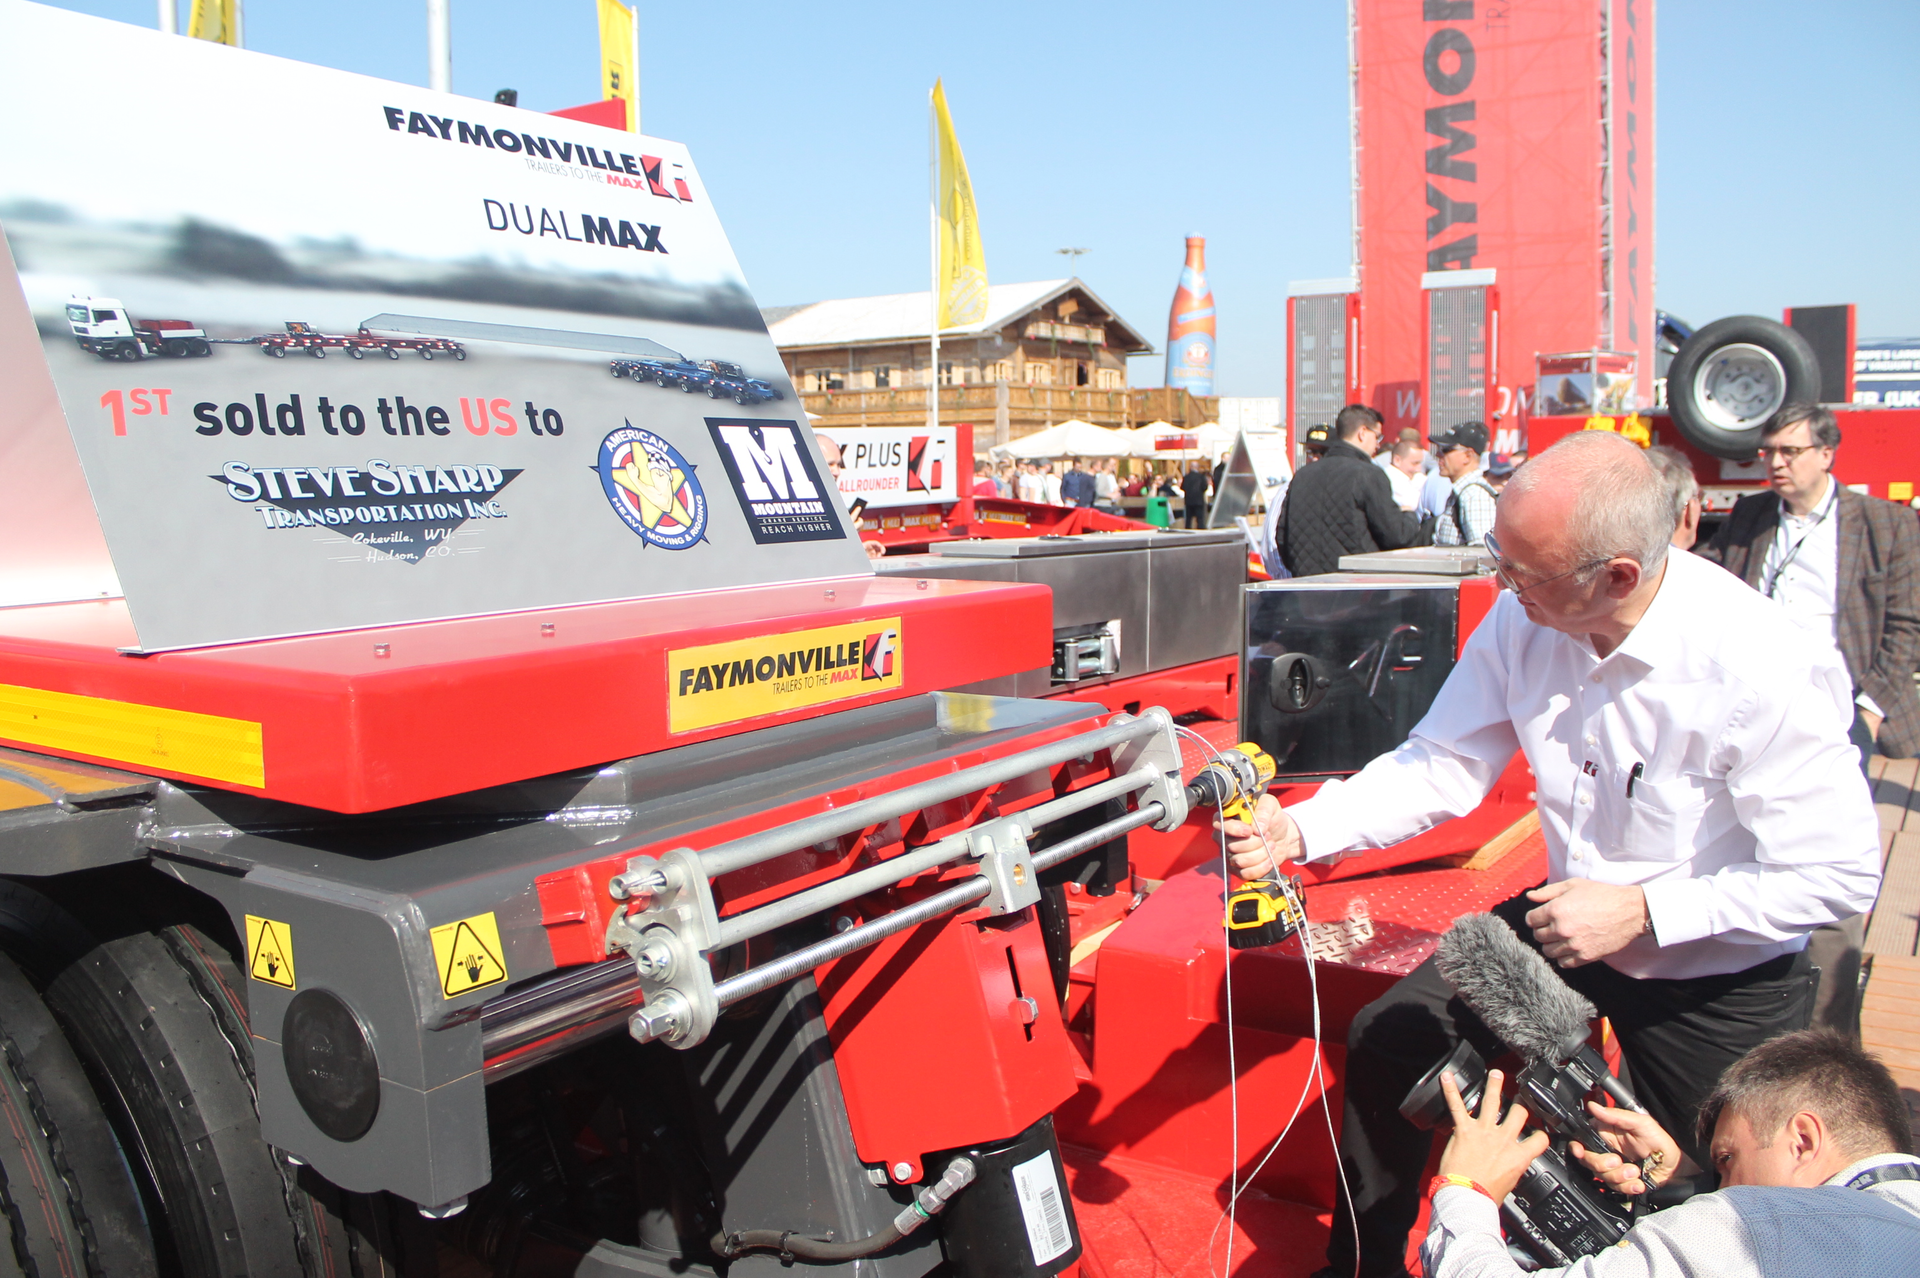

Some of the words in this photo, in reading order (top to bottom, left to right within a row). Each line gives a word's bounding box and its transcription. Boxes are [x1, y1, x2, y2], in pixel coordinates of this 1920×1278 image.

[383, 106, 641, 177] FAYMONVILLE
[524, 158, 568, 178] TRAILERS
[568, 166, 584, 180] TO
[584, 170, 604, 184] THE
[606, 174, 645, 191] MAX
[483, 198, 670, 255] DUALMAX
[100, 388, 173, 437] 1ST
[193, 393, 306, 437] sold
[318, 397, 366, 436] to
[377, 396, 451, 437] the
[459, 397, 518, 437] US
[525, 401, 564, 437] to
[604, 430, 669, 453] AMERICAN
[855, 442, 902, 469] PLUS
[222, 460, 366, 502] STEVE
[366, 458, 504, 497] SHARP
[839, 477, 900, 492] ALLROUNDER
[254, 503, 464, 530] TRANSPORTATION
[611, 497, 645, 533] HEAVY
[646, 530, 686, 546] MOVING
[685, 533, 694, 545] &
[690, 494, 704, 538] RIGGING
[751, 501, 825, 516] MOUNTAIN
[352, 531, 414, 546] Cokeville,
[761, 525, 794, 535] REACH
[797, 523, 833, 532] HIGHER
[365, 549, 419, 563] Hudson,
[679, 640, 861, 696] FAYMONVILLE
[772, 677, 803, 695] TRAILERS
[804, 676, 815, 690] TO
[816, 674, 828, 687] THE
[830, 668, 859, 684] MAX
